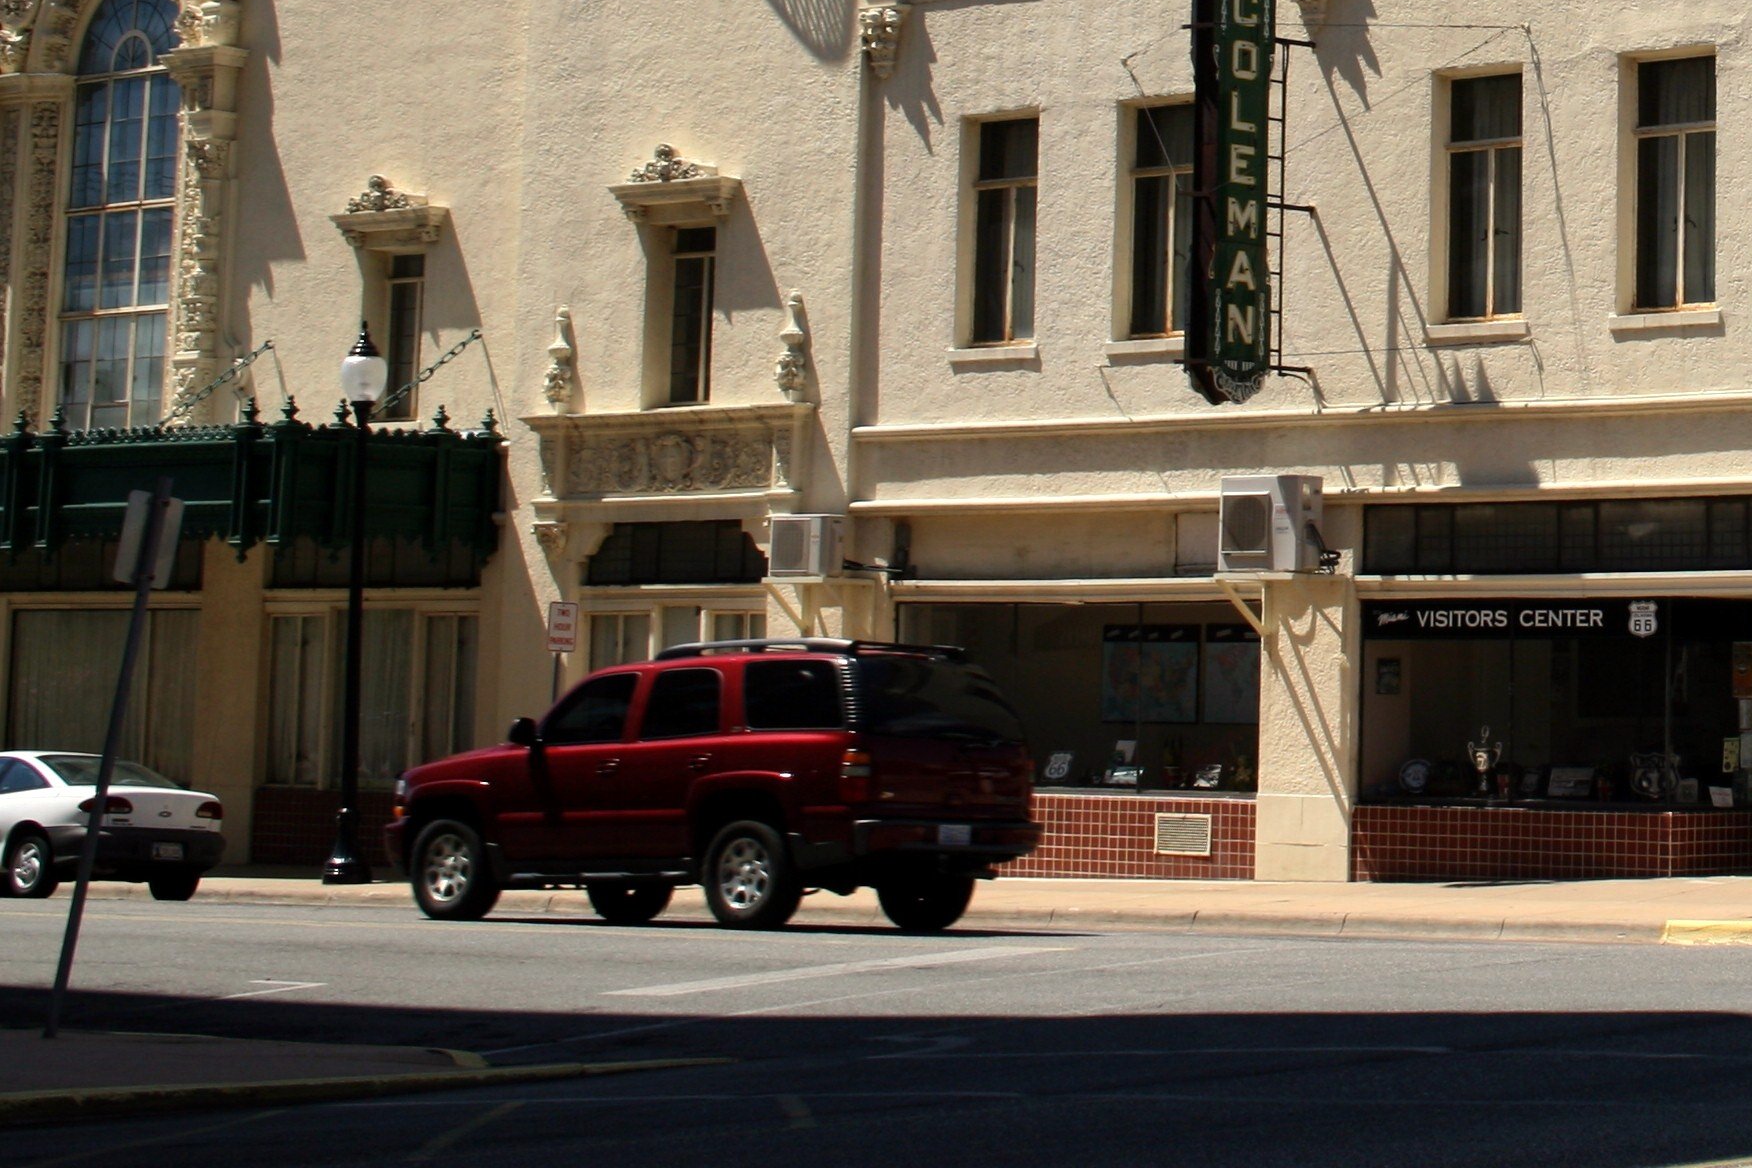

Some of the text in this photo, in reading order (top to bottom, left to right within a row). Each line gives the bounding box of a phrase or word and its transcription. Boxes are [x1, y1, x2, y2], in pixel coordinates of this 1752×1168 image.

[1416, 609, 1508, 628] VISITORS
[1519, 609, 1604, 628] CENTER
[1633, 619, 1652, 632] 66
[1048, 761, 1067, 776] 66
